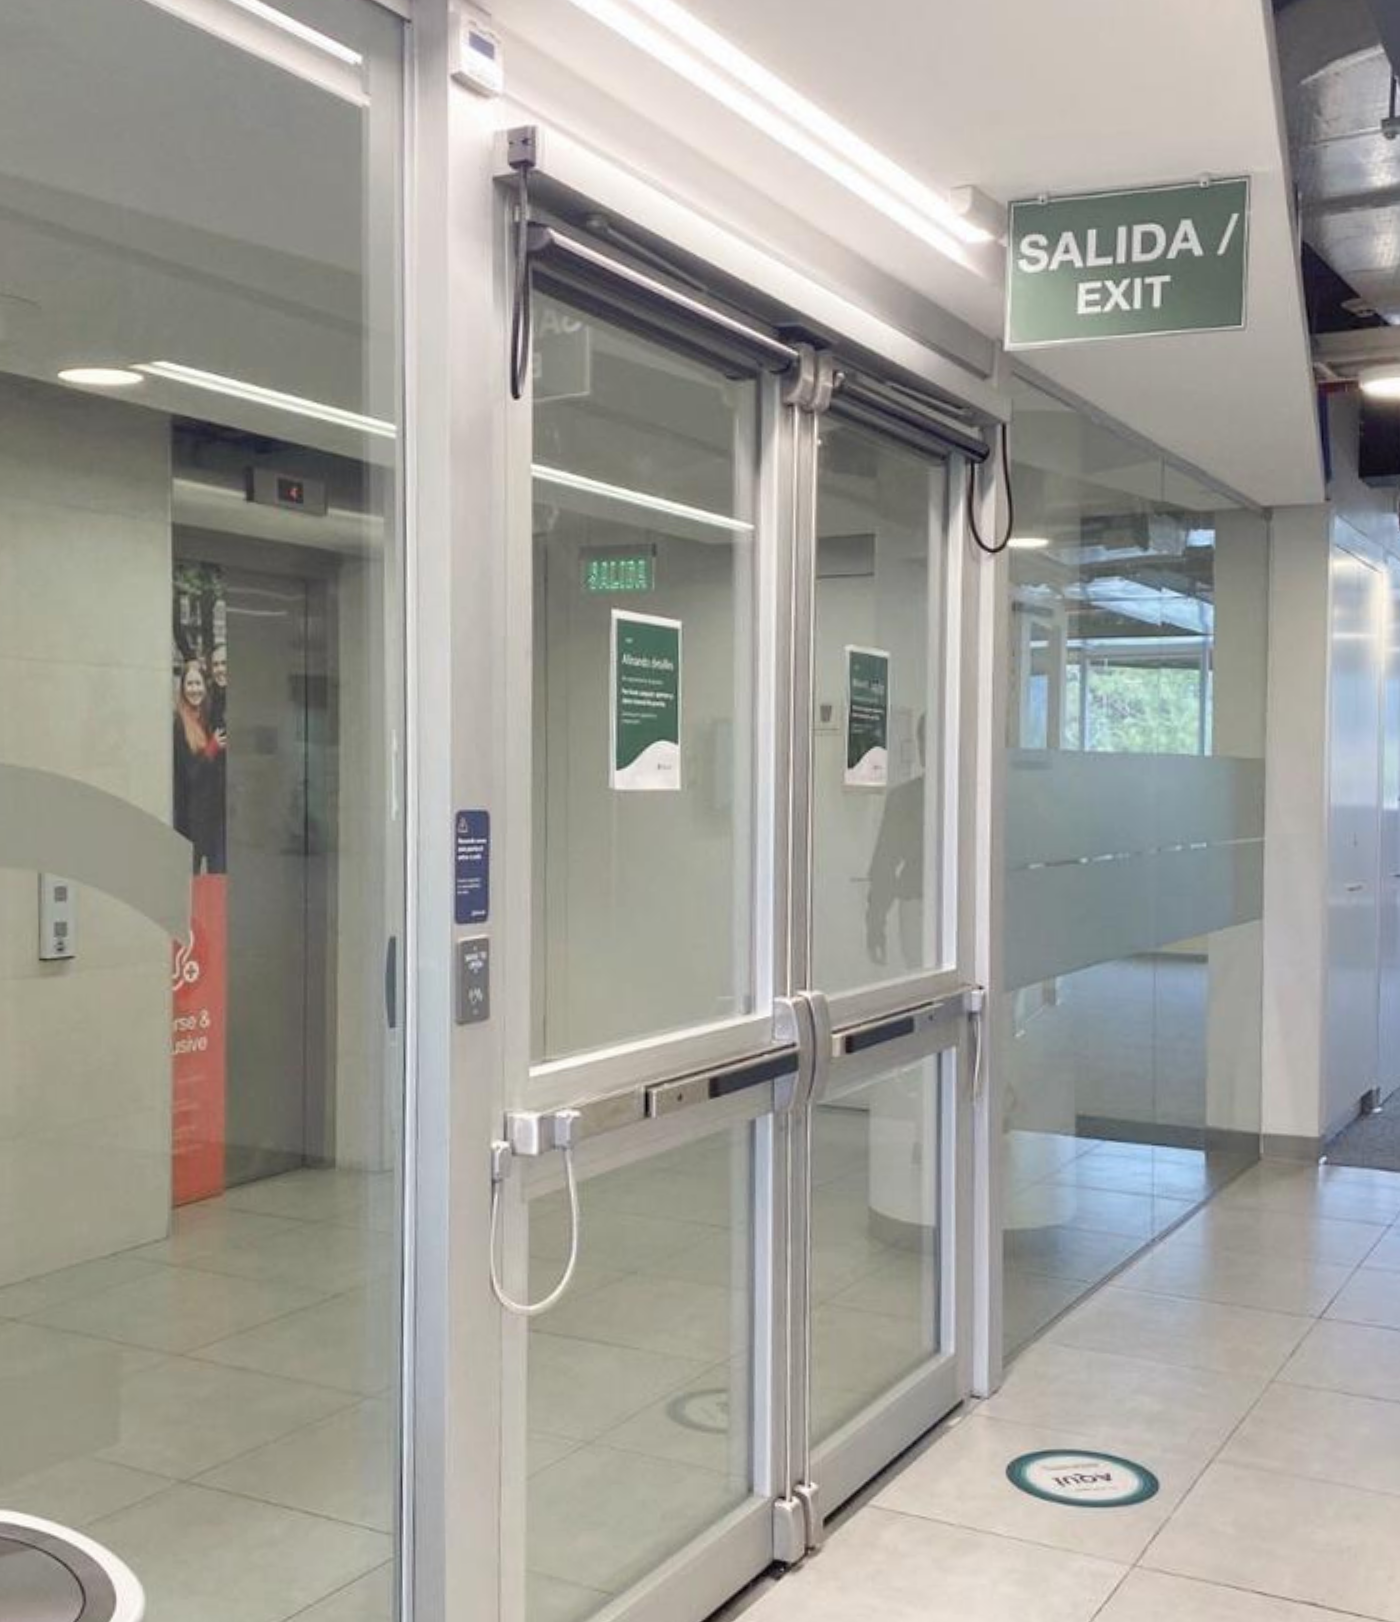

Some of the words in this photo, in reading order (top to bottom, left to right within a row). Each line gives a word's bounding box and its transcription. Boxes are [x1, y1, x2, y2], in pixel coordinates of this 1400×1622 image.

[1018, 218, 1204, 273] SALIDA
[1217, 213, 1240, 256] /
[1077, 275, 1172, 315] EXIT
[587, 560, 646, 590] SALIDA
